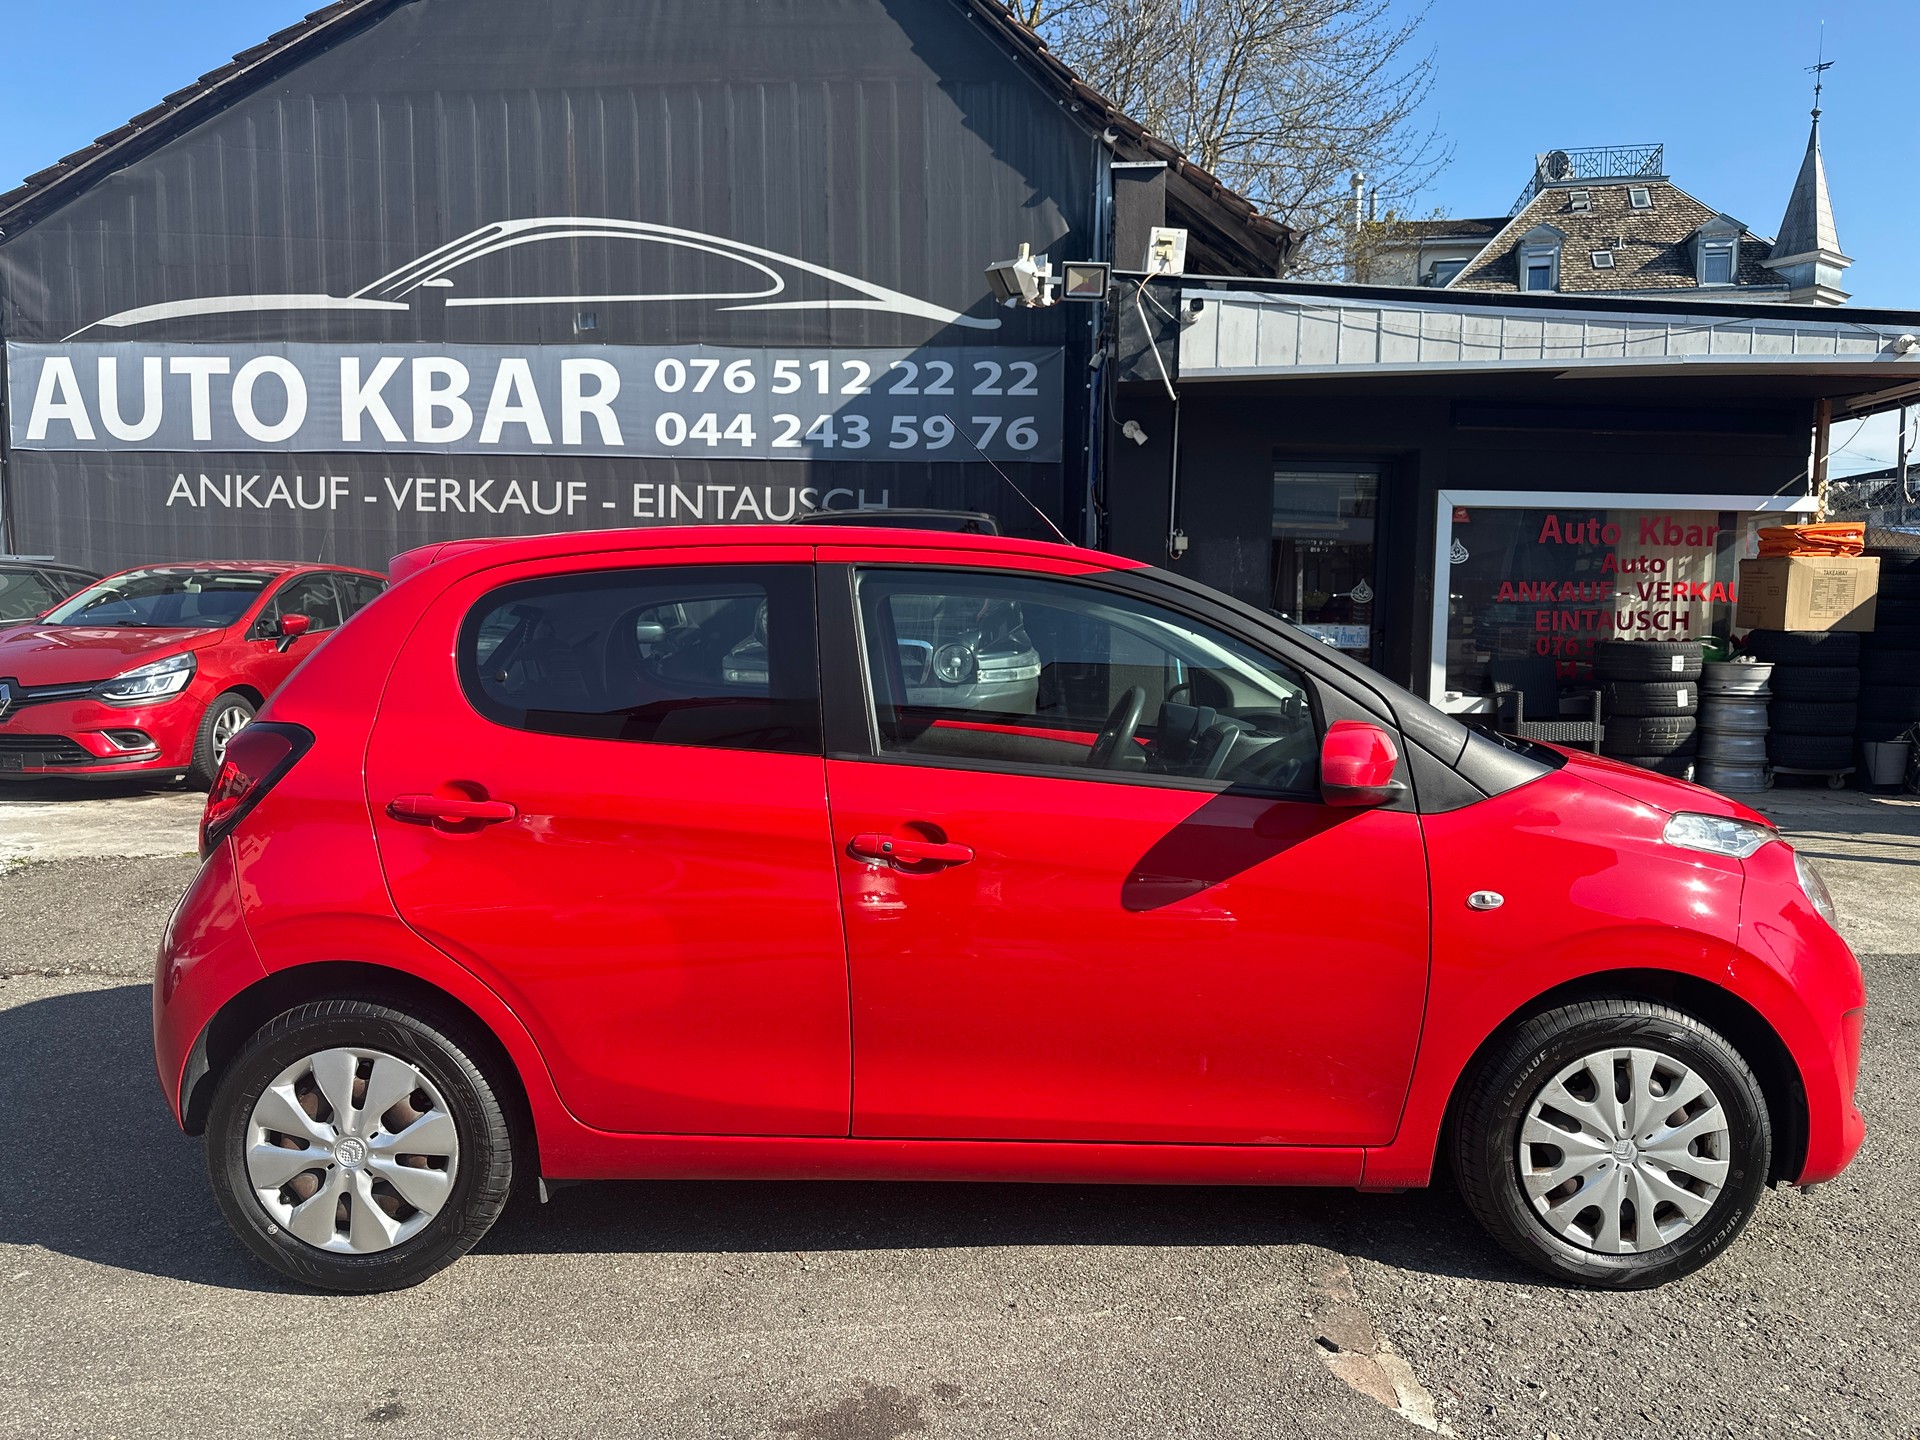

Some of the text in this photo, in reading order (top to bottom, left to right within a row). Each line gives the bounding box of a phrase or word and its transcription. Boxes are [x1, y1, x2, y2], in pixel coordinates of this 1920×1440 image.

[654, 358, 1039, 396] 076 512 22 22
[26, 354, 625, 446] AUTO KBAR
[655, 412, 1039, 451] 044 243 59 76
[166, 473, 350, 511] ANKAUF
[634, 484, 889, 521] EINTAUSCH
[1538, 514, 1720, 547] Auto Kbar
[1601, 553, 1666, 574] Auto
[1497, 581, 1614, 602] ANKAUF
[1636, 581, 1738, 603] VERKAU
[1535, 610, 1690, 631] EINTAUSCH
[1536, 636, 1580, 656] 076
[1699, 1208, 1743, 1258] SUPERIA
